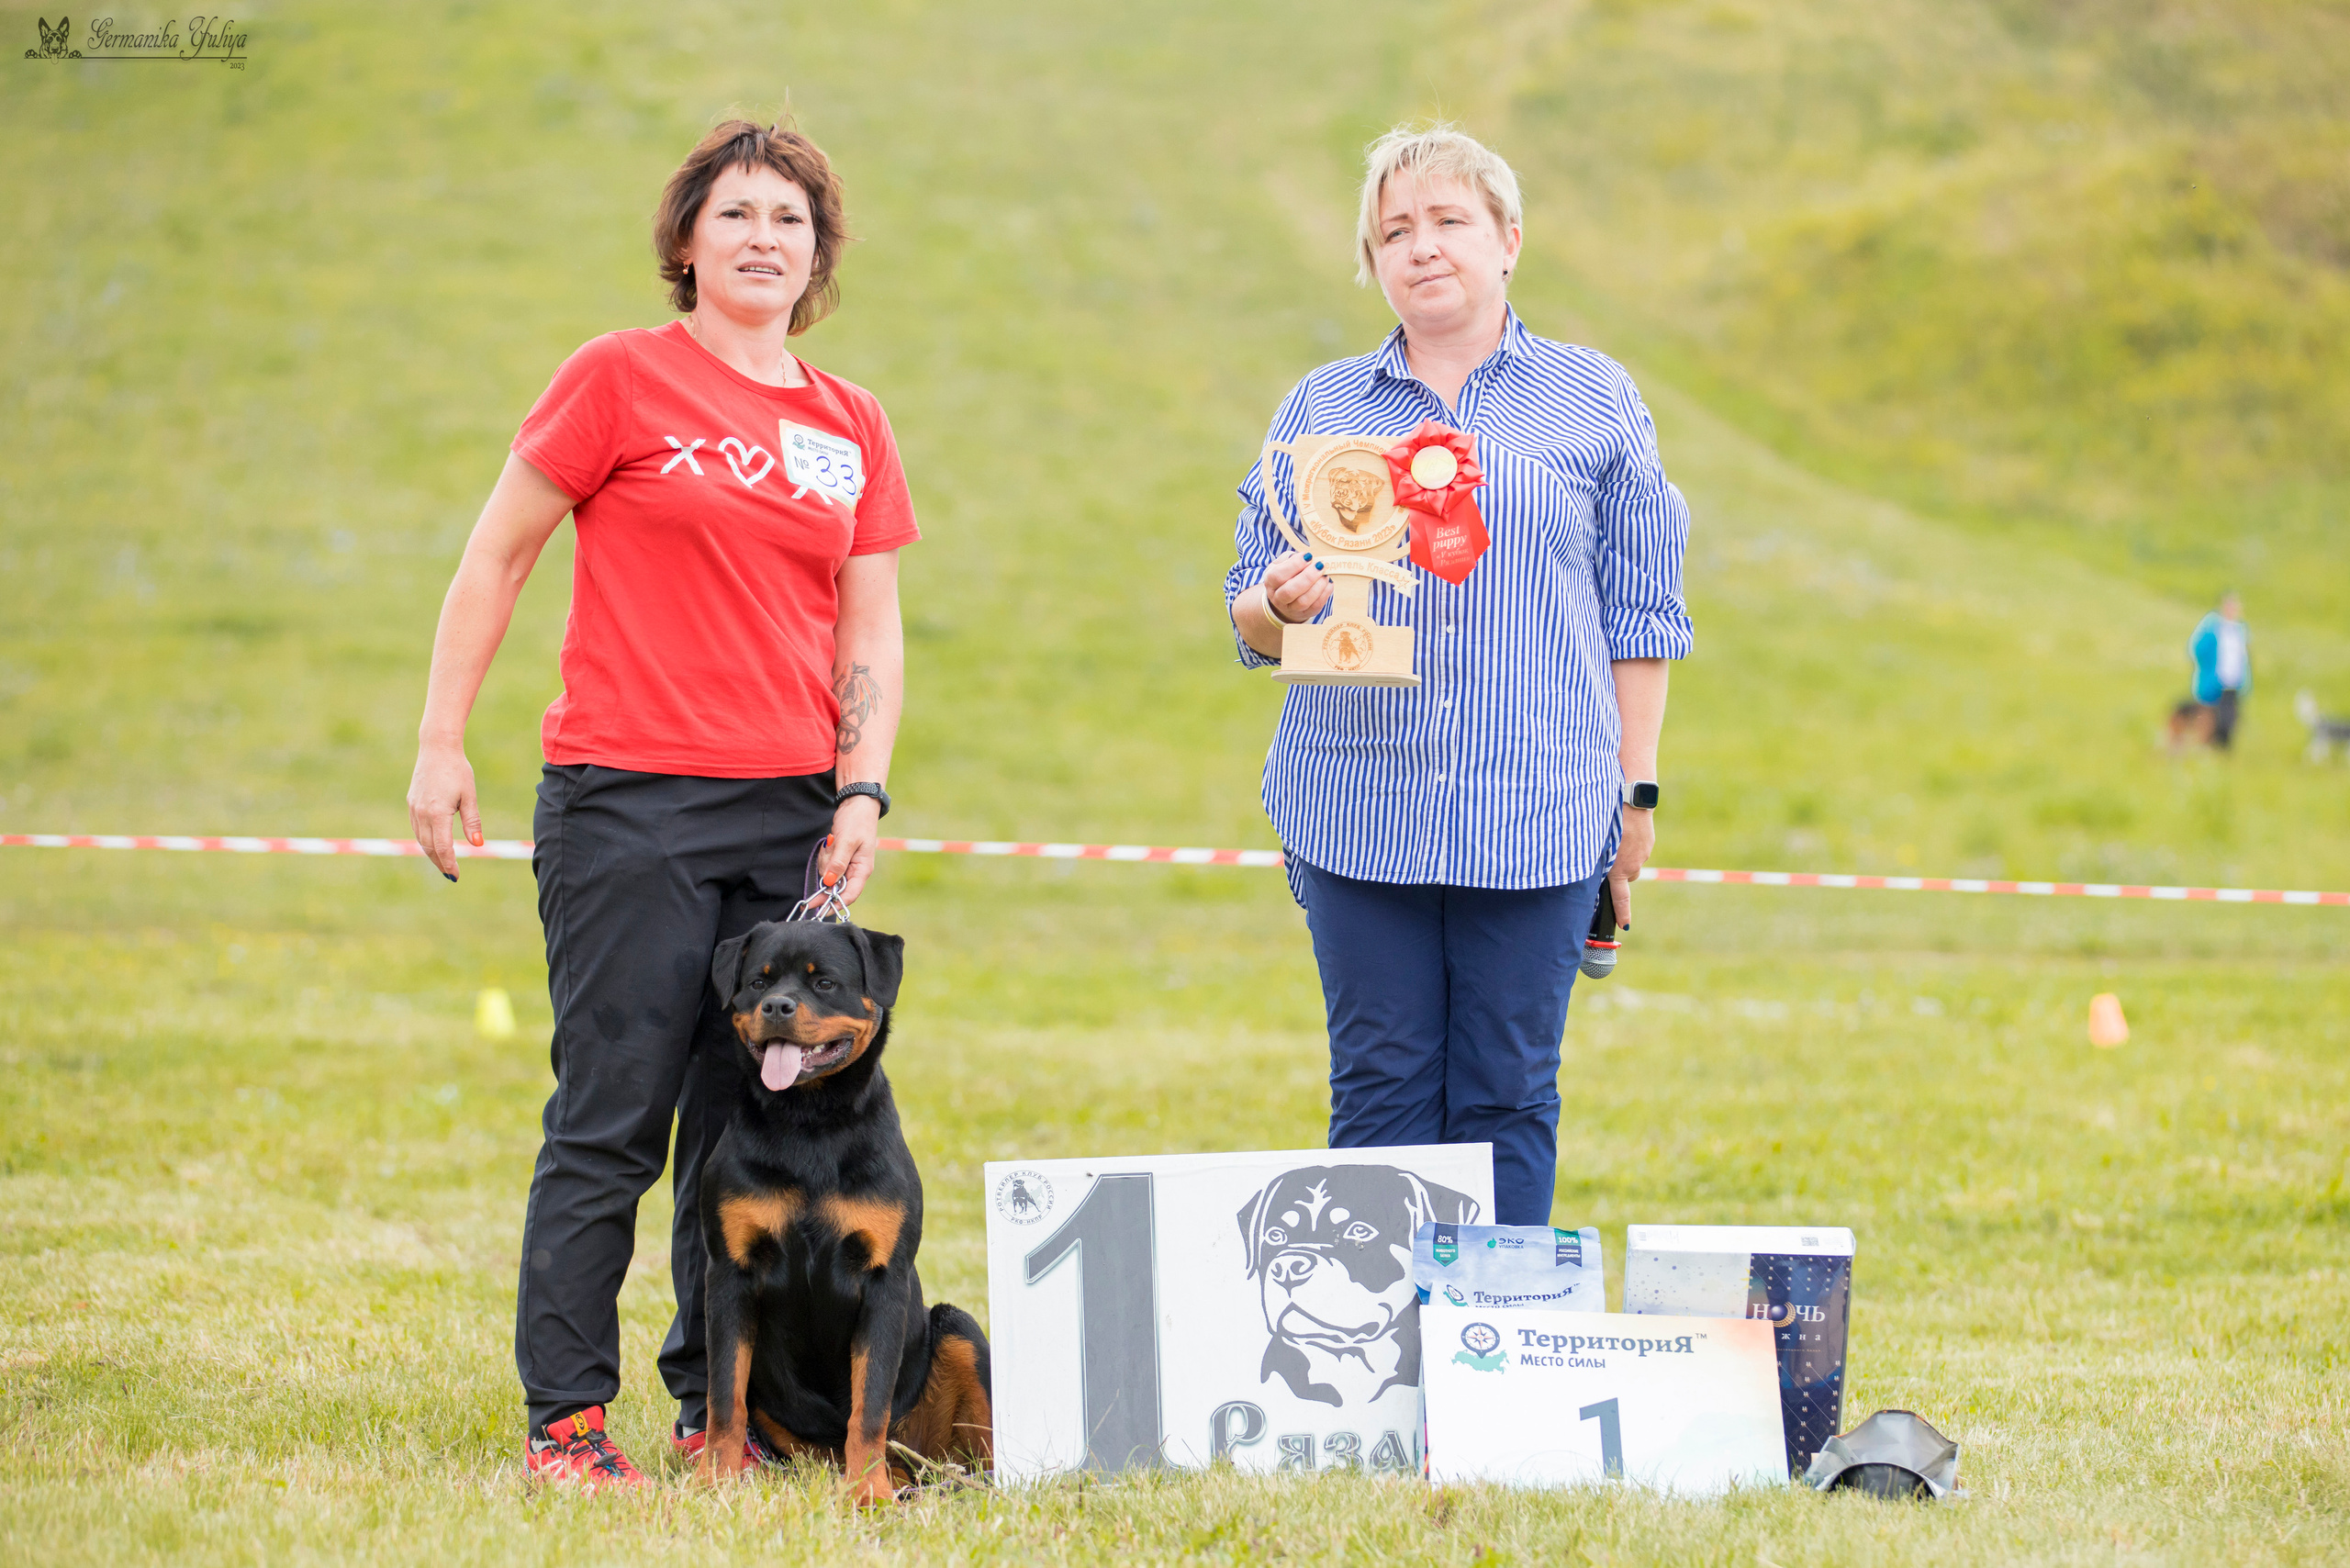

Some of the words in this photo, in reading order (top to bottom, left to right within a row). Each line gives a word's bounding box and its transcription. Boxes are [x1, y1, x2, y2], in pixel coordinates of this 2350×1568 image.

[816, 455, 856, 496] 33
[1302, 441, 1351, 500] Межрегиональный
[1353, 440, 1387, 454] Чемпио
[1436, 524, 1460, 539] Best
[1337, 536, 1371, 548] Рязани
[1432, 534, 1467, 553] puppy
[1324, 561, 1364, 571] едитель
[1367, 562, 1400, 580] Класса
[996, 1171, 1019, 1212] РОТВЕЙЛЕР
[1022, 1171, 1042, 1180] КЛУБ
[1043, 1180, 1054, 1210] РОССИИ
[1437, 1234, 1453, 1244] 80%
[1558, 1236, 1579, 1244] 100%
[1024, 1171, 1179, 1474] 1
[1579, 1397, 1625, 1480] 1
